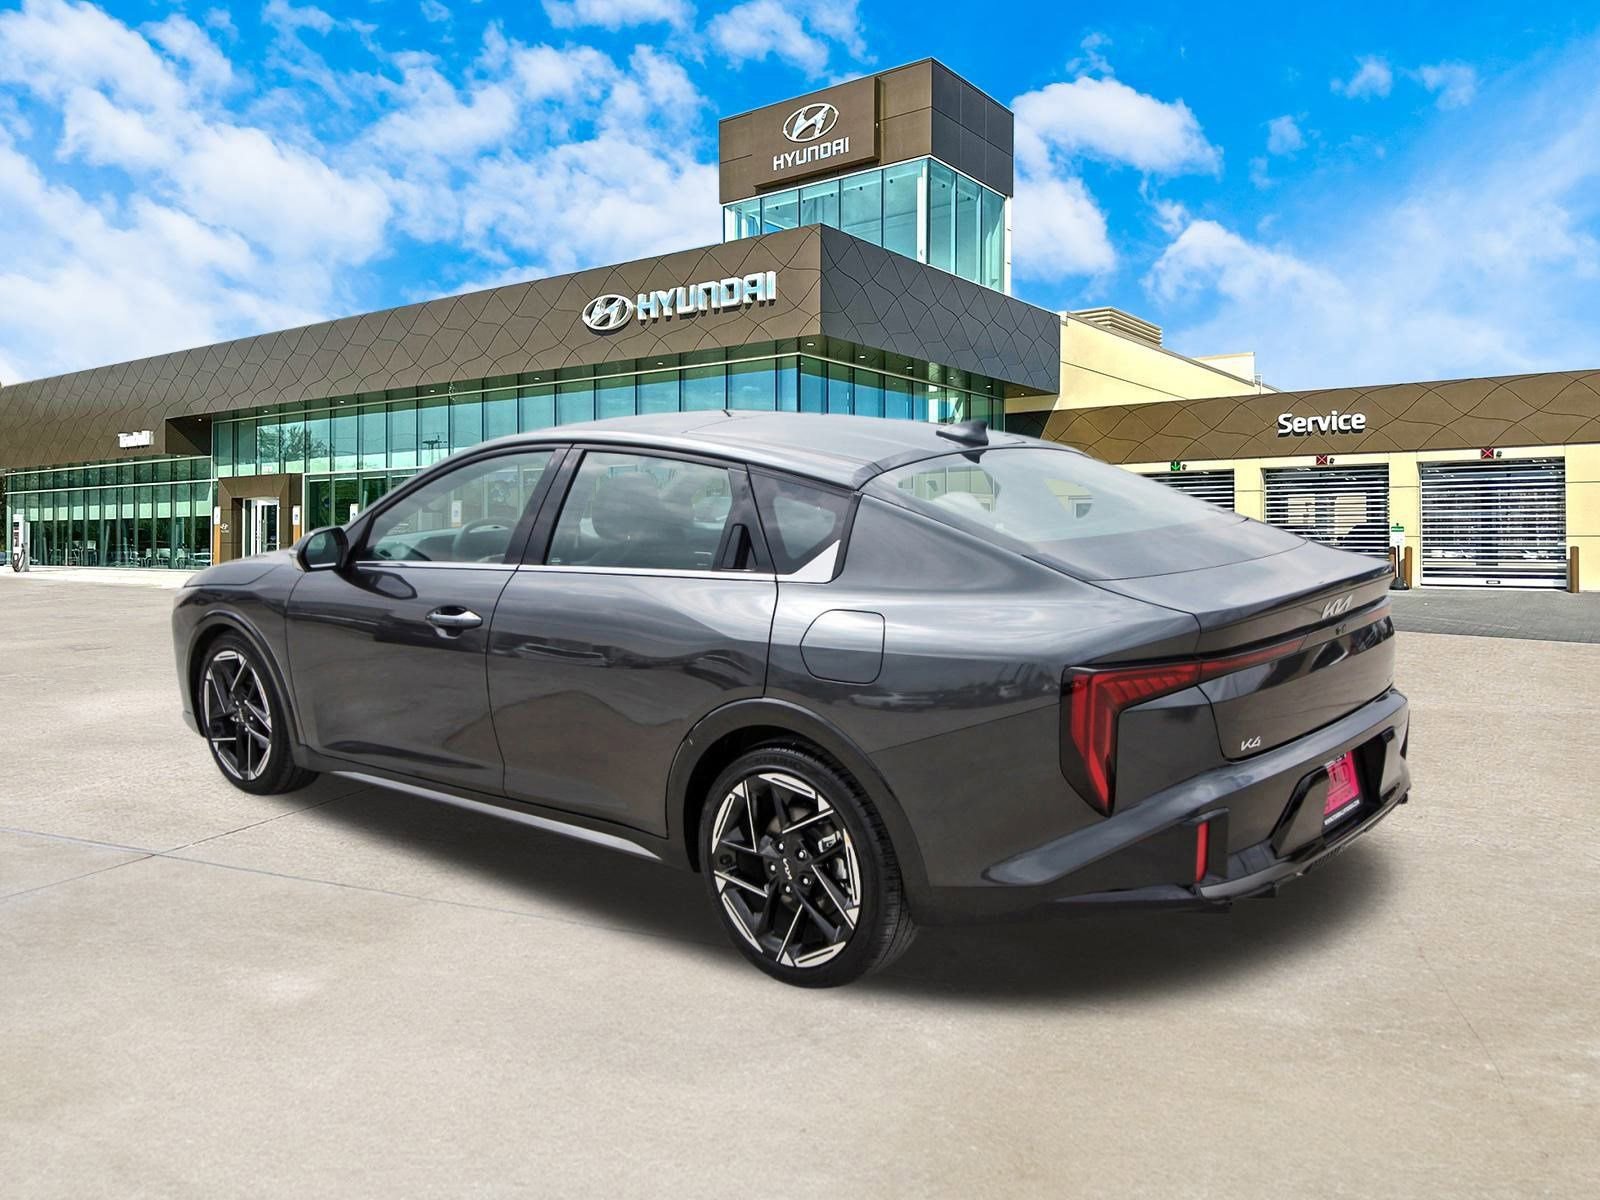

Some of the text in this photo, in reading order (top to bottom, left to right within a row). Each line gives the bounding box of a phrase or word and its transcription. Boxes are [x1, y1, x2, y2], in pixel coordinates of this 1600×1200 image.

[773, 136, 850, 171] HYUNDAI
[637, 271, 777, 321] HYUNDAI
[1277, 410, 1367, 435] Service
[1240, 735, 1261, 751] K4
